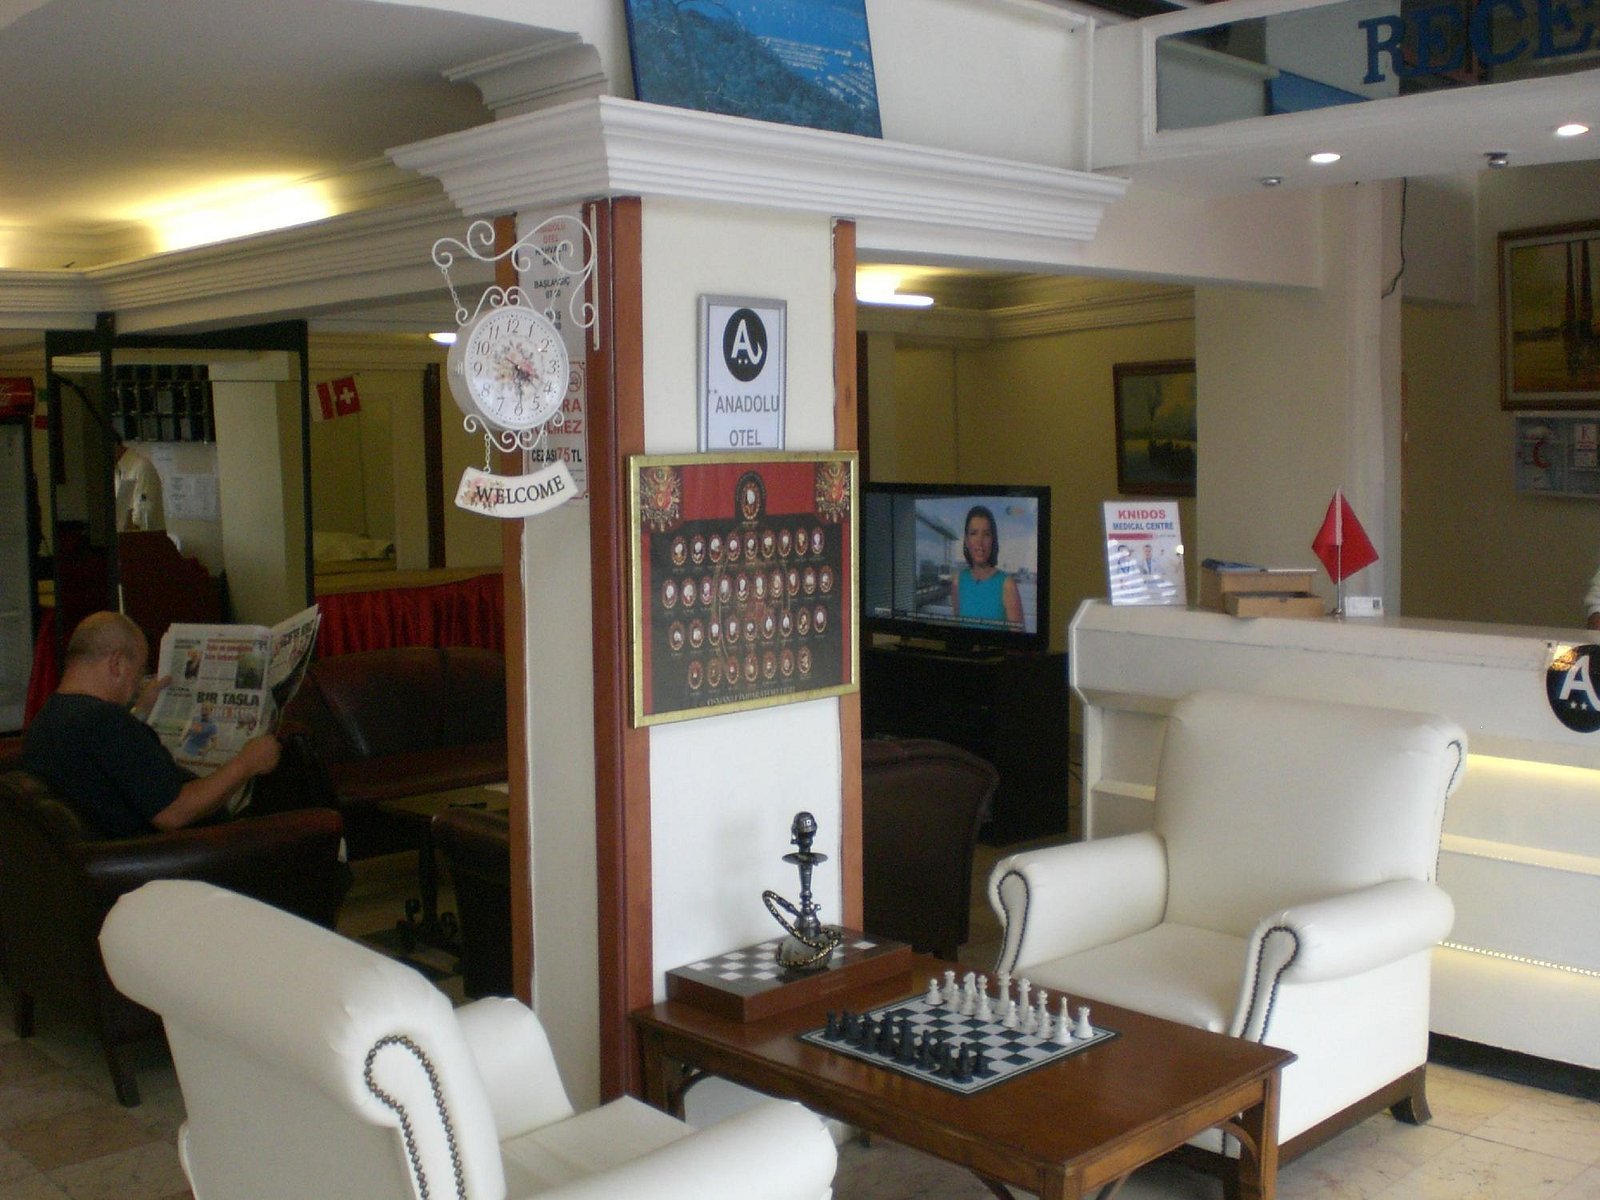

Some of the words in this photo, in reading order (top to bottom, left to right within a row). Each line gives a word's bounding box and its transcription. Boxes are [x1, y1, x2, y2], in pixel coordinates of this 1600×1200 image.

[1358, 0, 1600, 84] RECE
[489, 325, 500, 340] 11
[507, 318, 520, 334] 12
[528, 321, 536, 338] 1
[476, 341, 490, 356] 10
[540, 338, 550, 353] 2
[473, 361, 483, 376] 9
[547, 359, 557, 374] 3
[481, 383, 491, 397] 8
[543, 380, 552, 395] 4
[496, 397, 505, 413] 7
[514, 400, 523, 416] 6
[532, 396, 540, 411] 5
[715, 394, 779, 414] ANADOLU
[729, 429, 762, 447] OTEL
[557, 447, 571, 463] 75
[571, 449, 583, 463] TL
[476, 475, 565, 505] WELCOME
[1118, 509, 1166, 520] KNIDOS
[1112, 522, 1145, 531] MEDICAL
[1145, 522, 1175, 531] CENTRE
